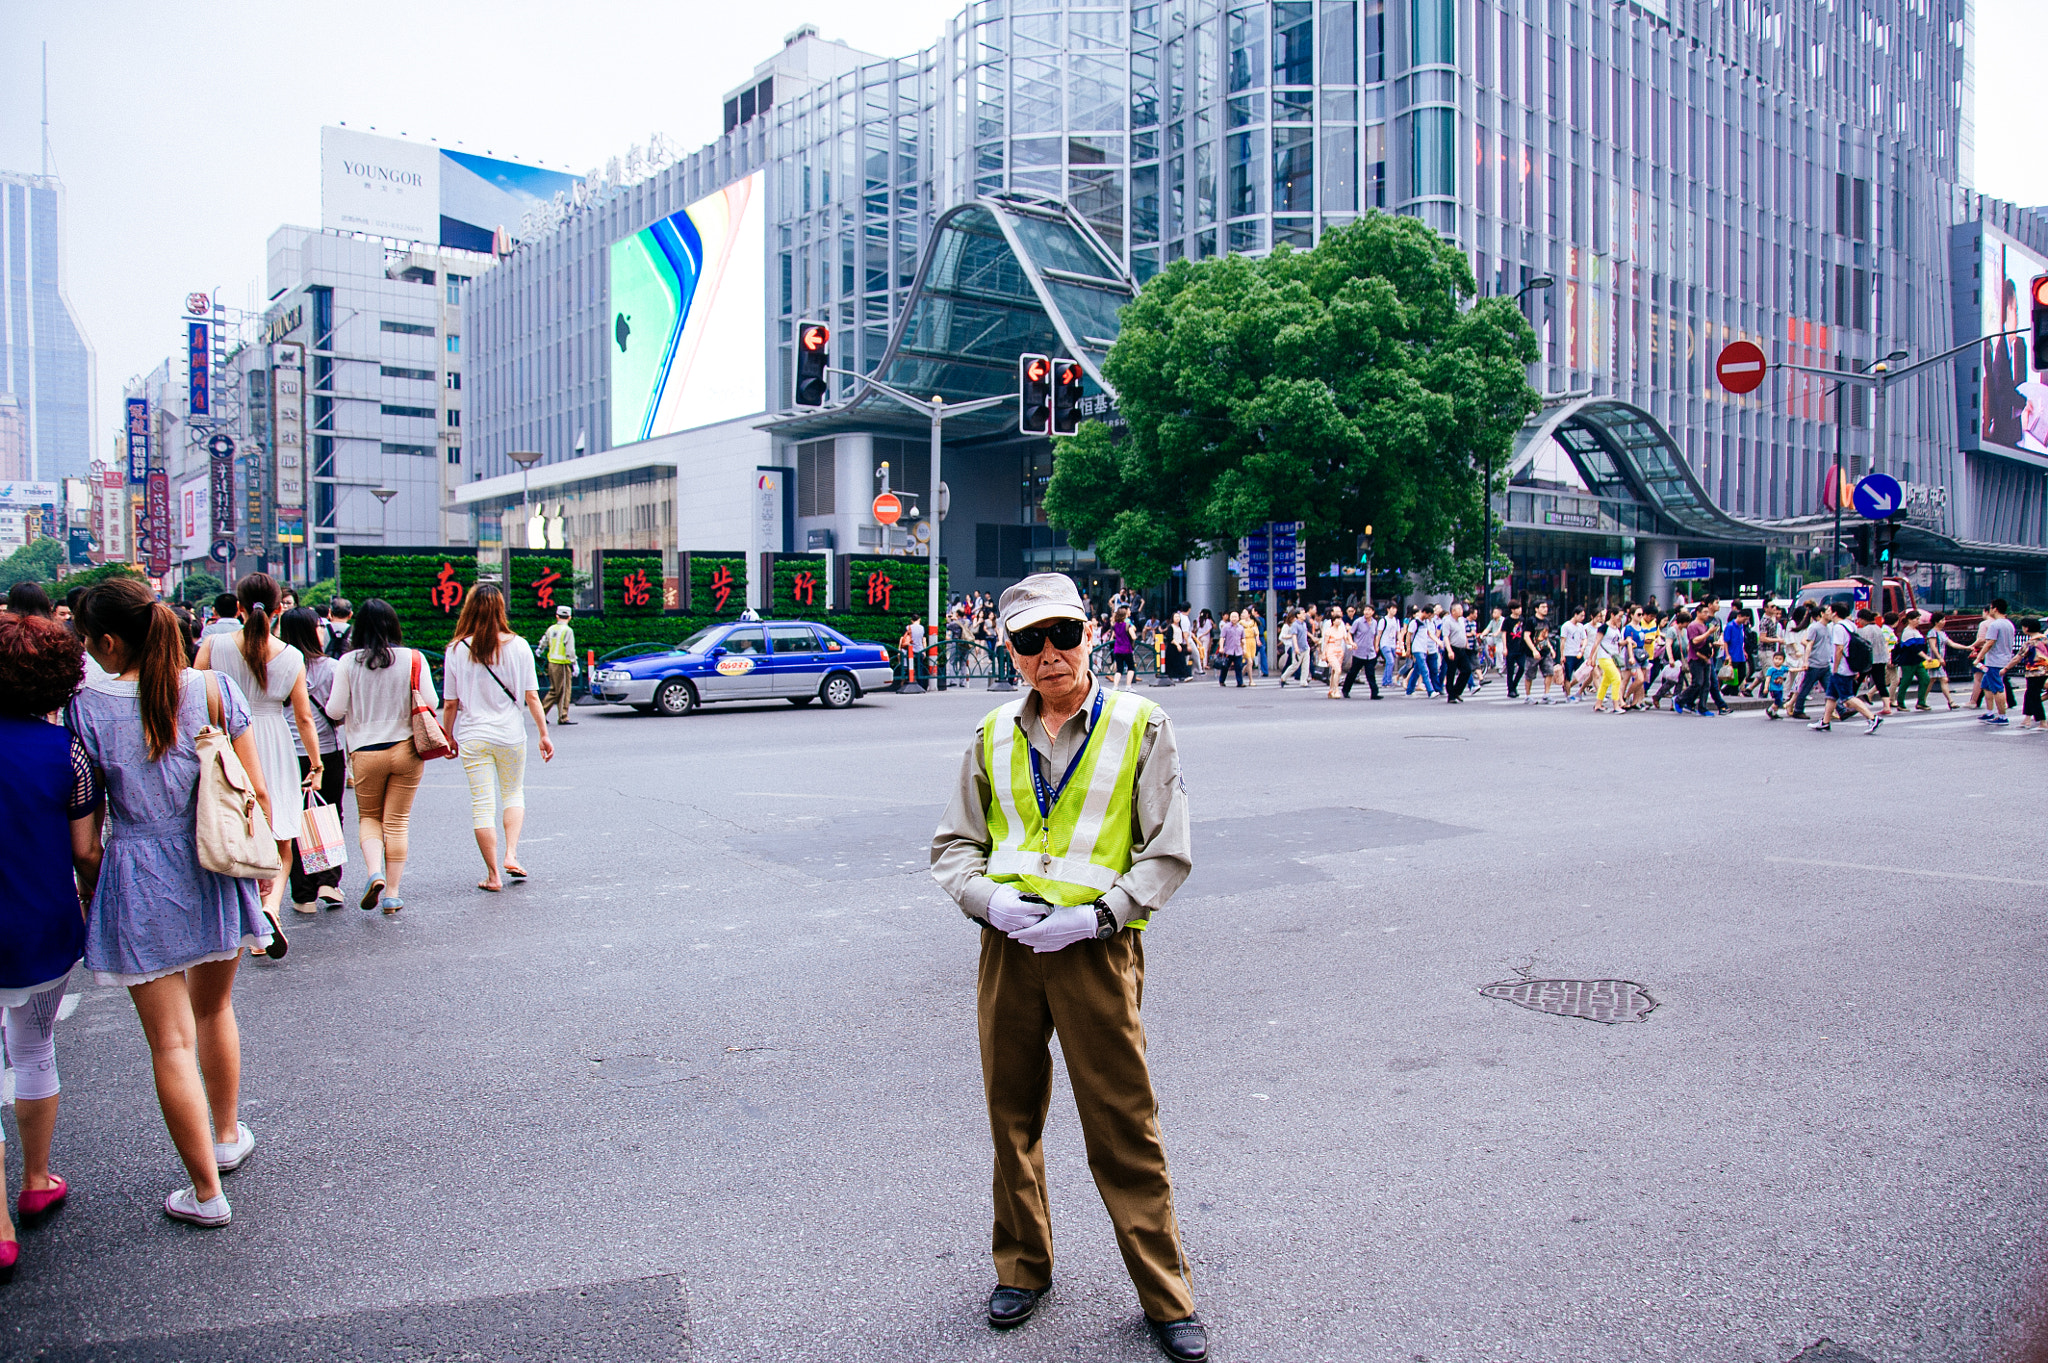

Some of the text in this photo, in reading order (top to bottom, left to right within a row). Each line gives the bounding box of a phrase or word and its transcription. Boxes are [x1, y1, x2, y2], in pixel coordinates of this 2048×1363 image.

[343, 160, 423, 187] YOUNGOR
[431, 562, 892, 612] 南京路步行街
